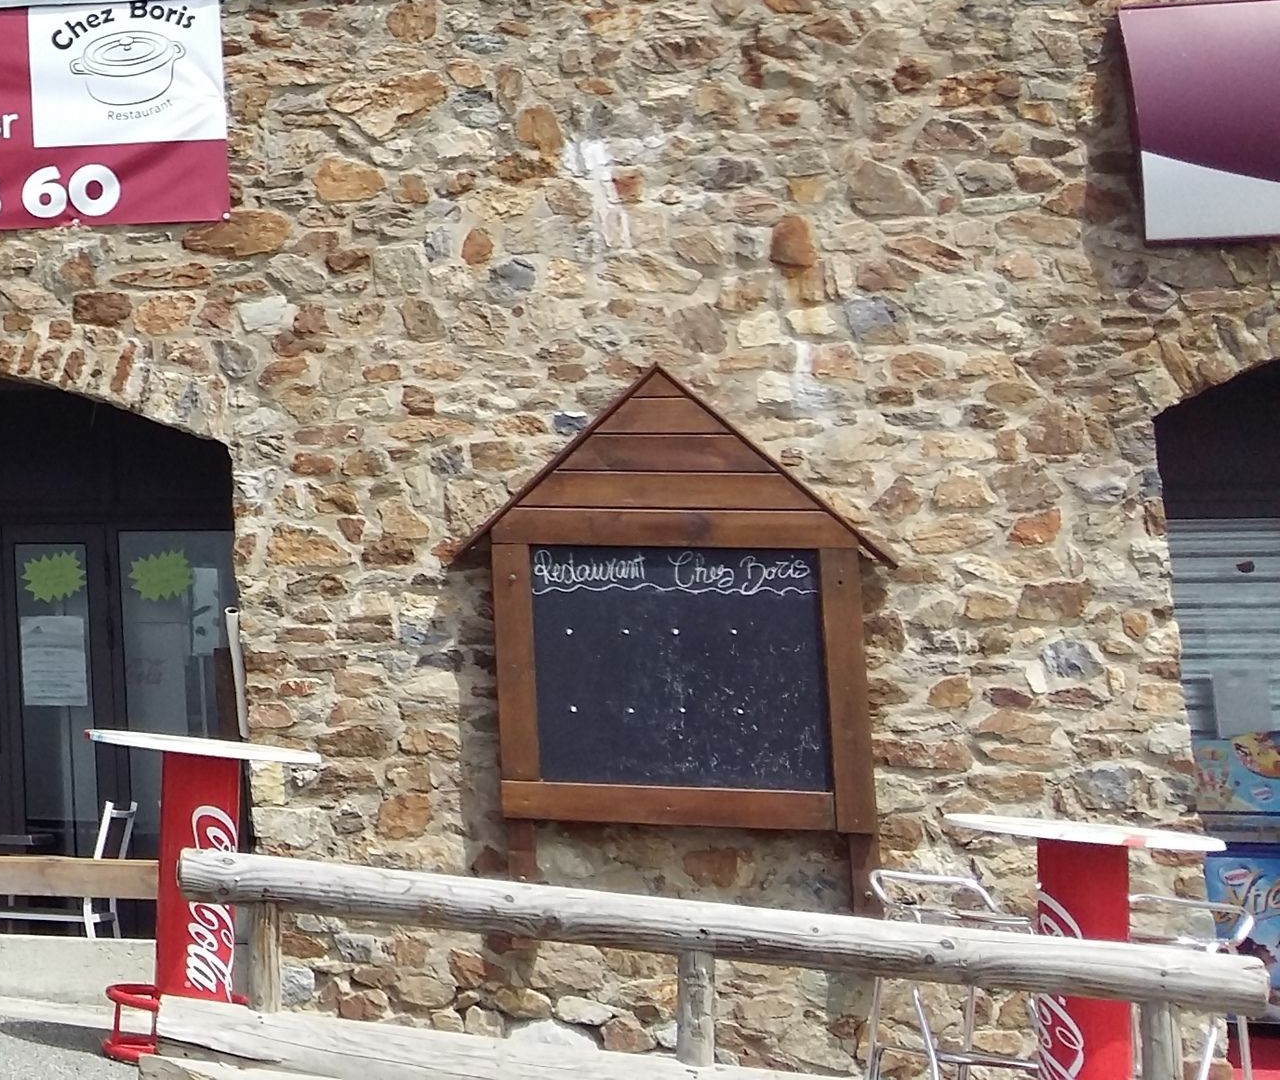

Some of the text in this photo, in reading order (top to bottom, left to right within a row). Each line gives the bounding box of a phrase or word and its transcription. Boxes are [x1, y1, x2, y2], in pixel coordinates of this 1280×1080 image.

[51, 0, 196, 51] Chez Boris
[107, 98, 174, 121] Restaurant
[21, 162, 122, 219] 60
[534, 549, 646, 585] Restaurant
